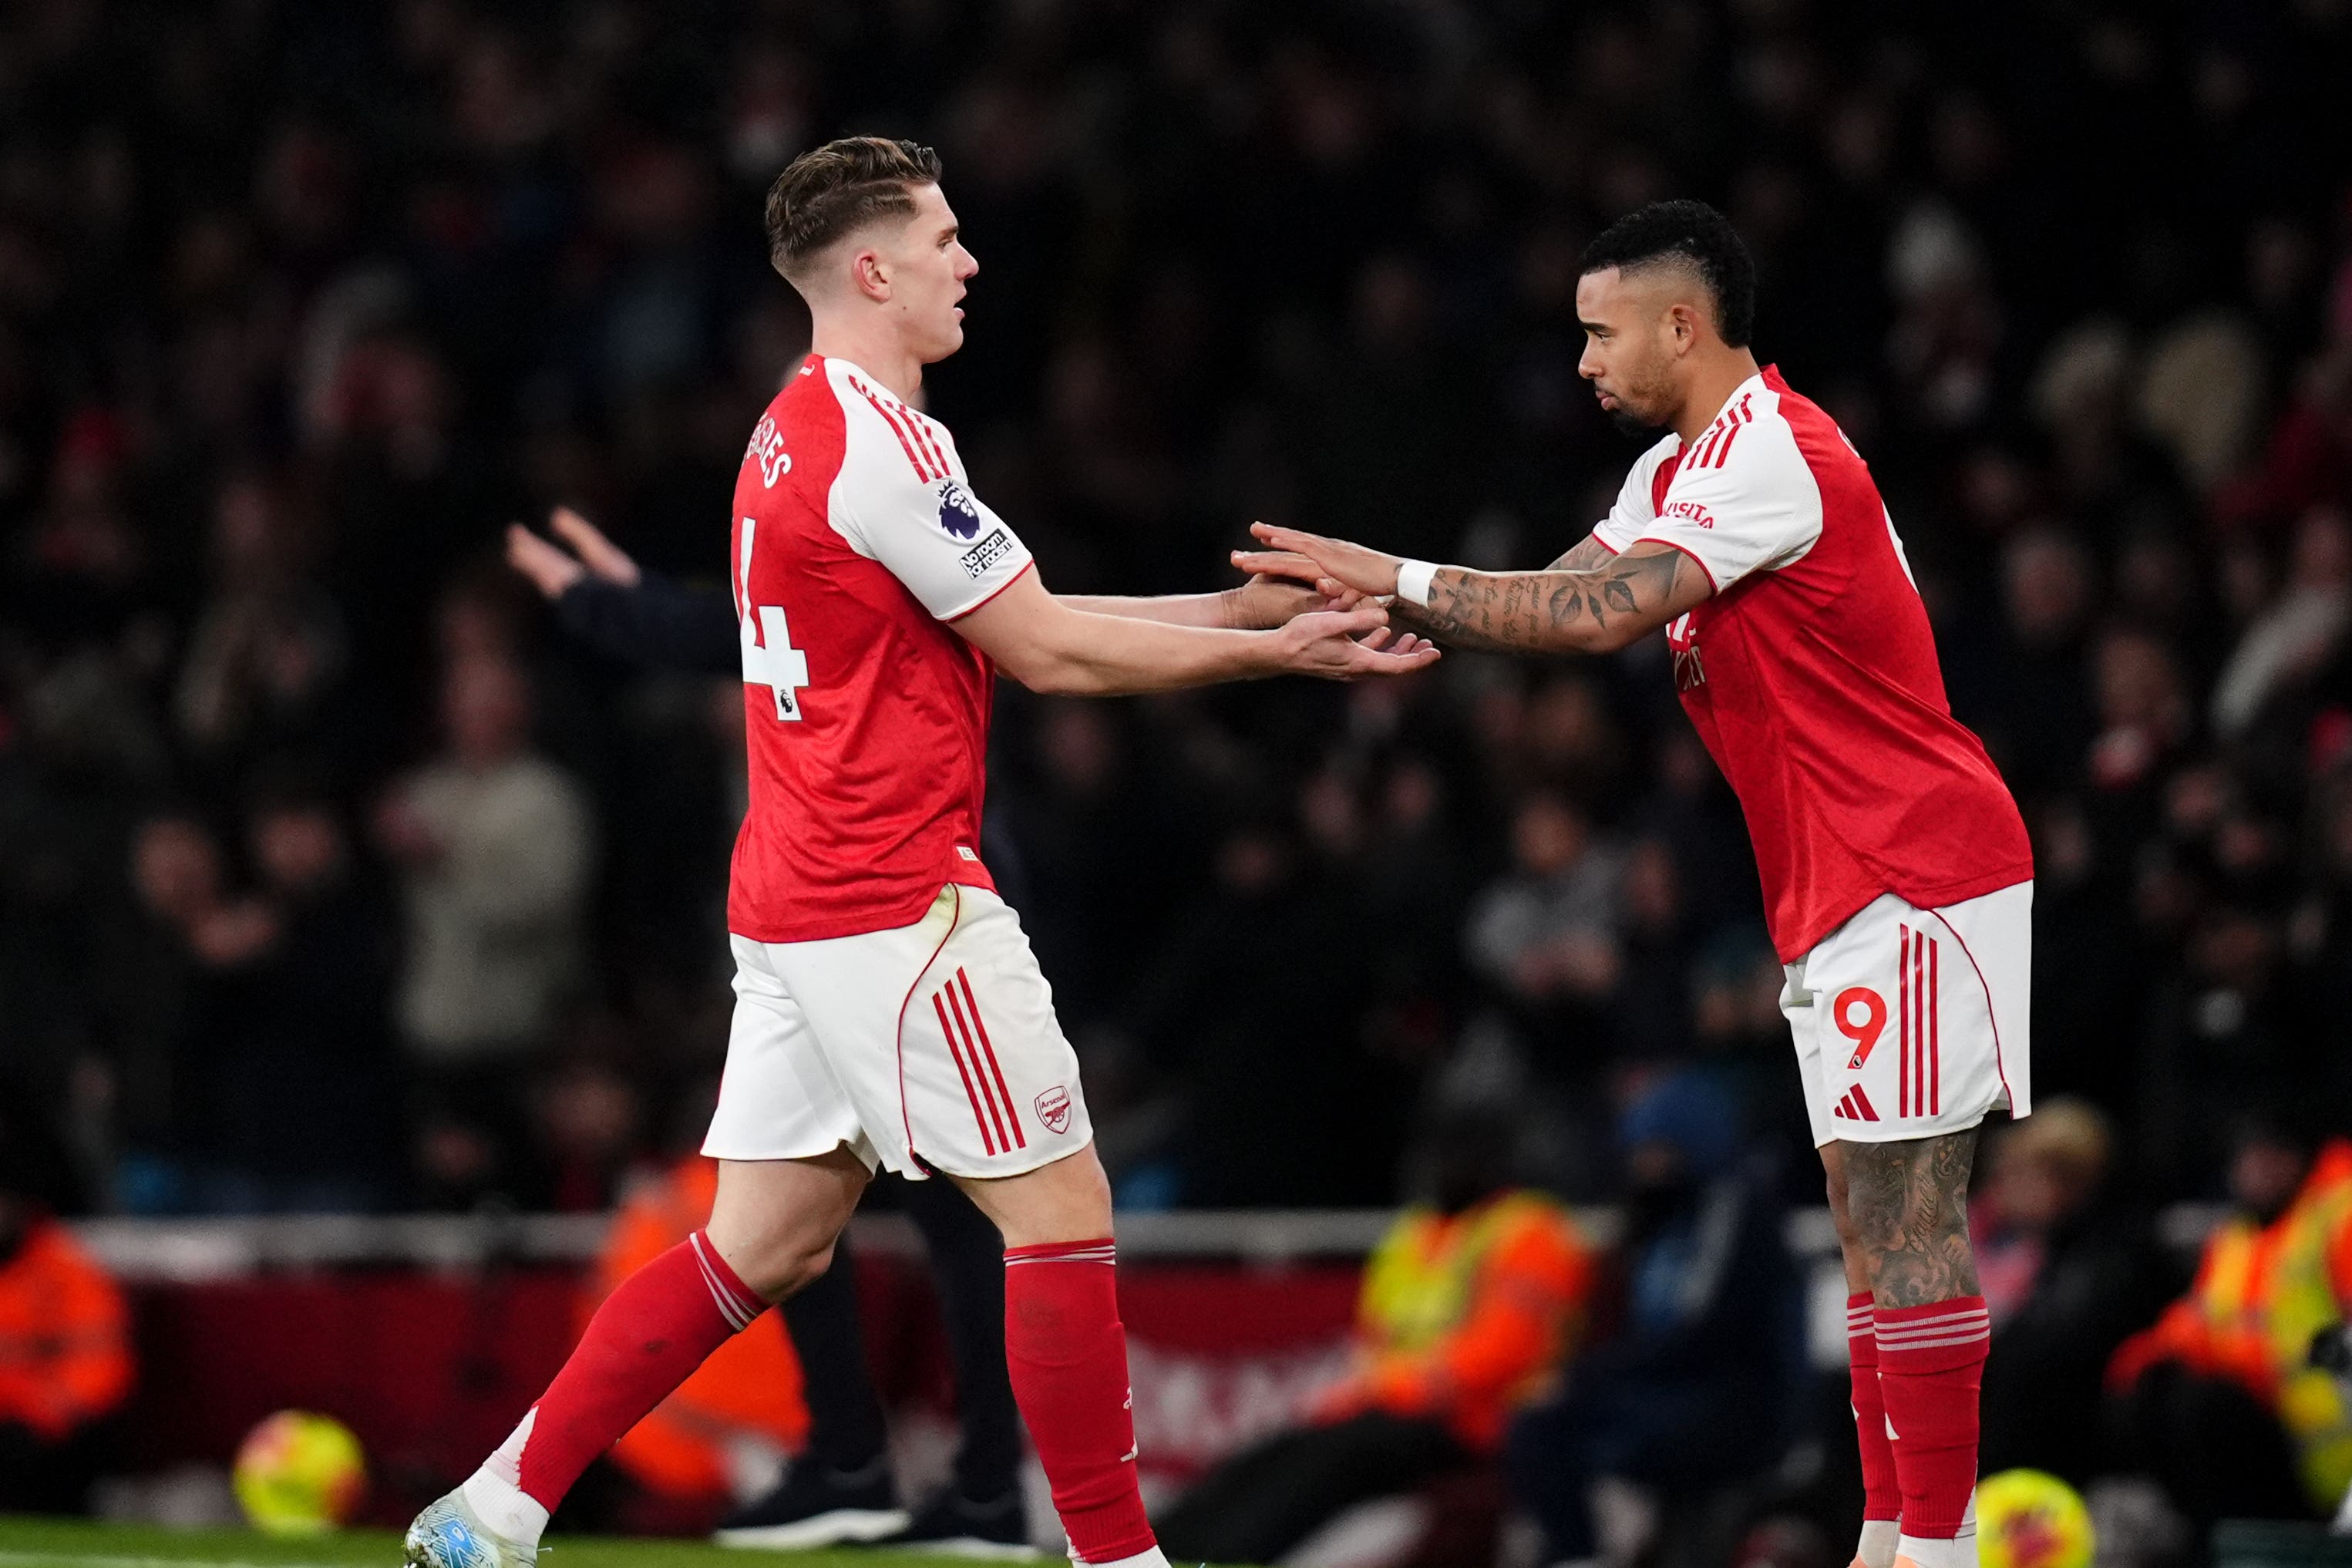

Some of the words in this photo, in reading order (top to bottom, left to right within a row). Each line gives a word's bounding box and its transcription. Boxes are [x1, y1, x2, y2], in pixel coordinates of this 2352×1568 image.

[959, 553, 979, 570] No
[975, 533, 1004, 559] room
[969, 560, 984, 580] for
[981, 538, 1013, 567] racism
[1834, 987, 1887, 1069] 9
